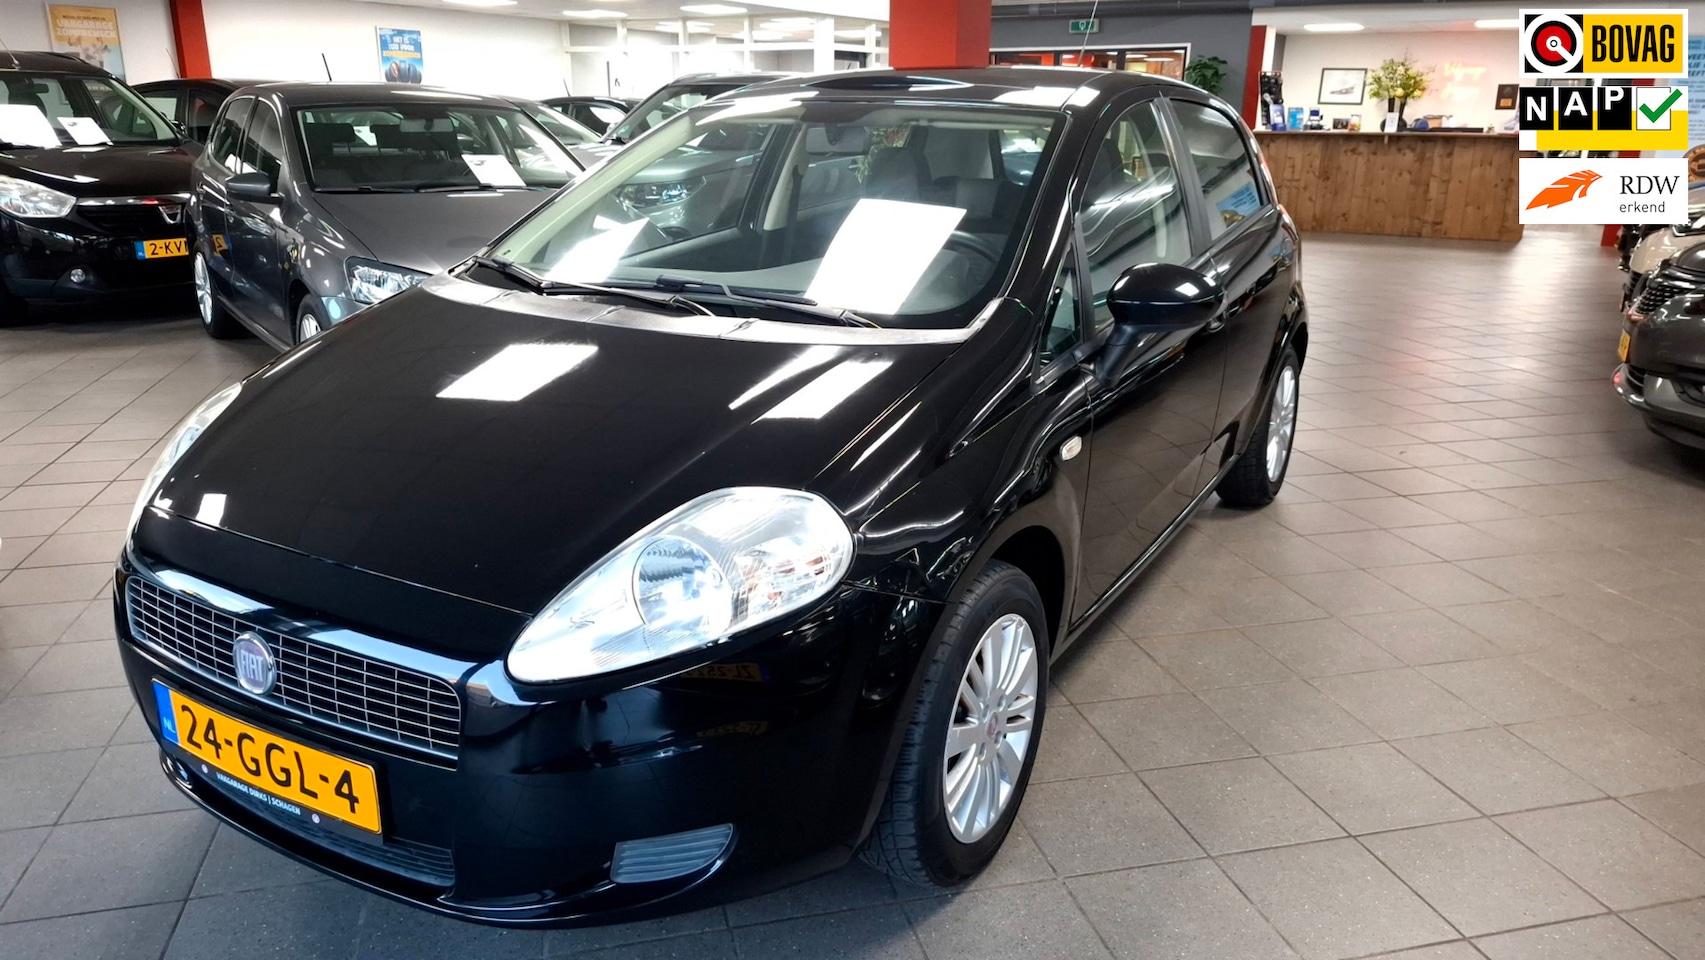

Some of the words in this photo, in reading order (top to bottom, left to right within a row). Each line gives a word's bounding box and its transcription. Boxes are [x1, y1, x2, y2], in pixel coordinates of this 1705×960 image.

[240, 649, 264, 682] FIAT
[163, 717, 176, 734] NL
[180, 703, 360, 815] 24-GGL-4
[215, 771, 249, 794] VAKGARAGE
[248, 788, 268, 802] DIRKS
[271, 797, 301, 816] SCHAGEN
